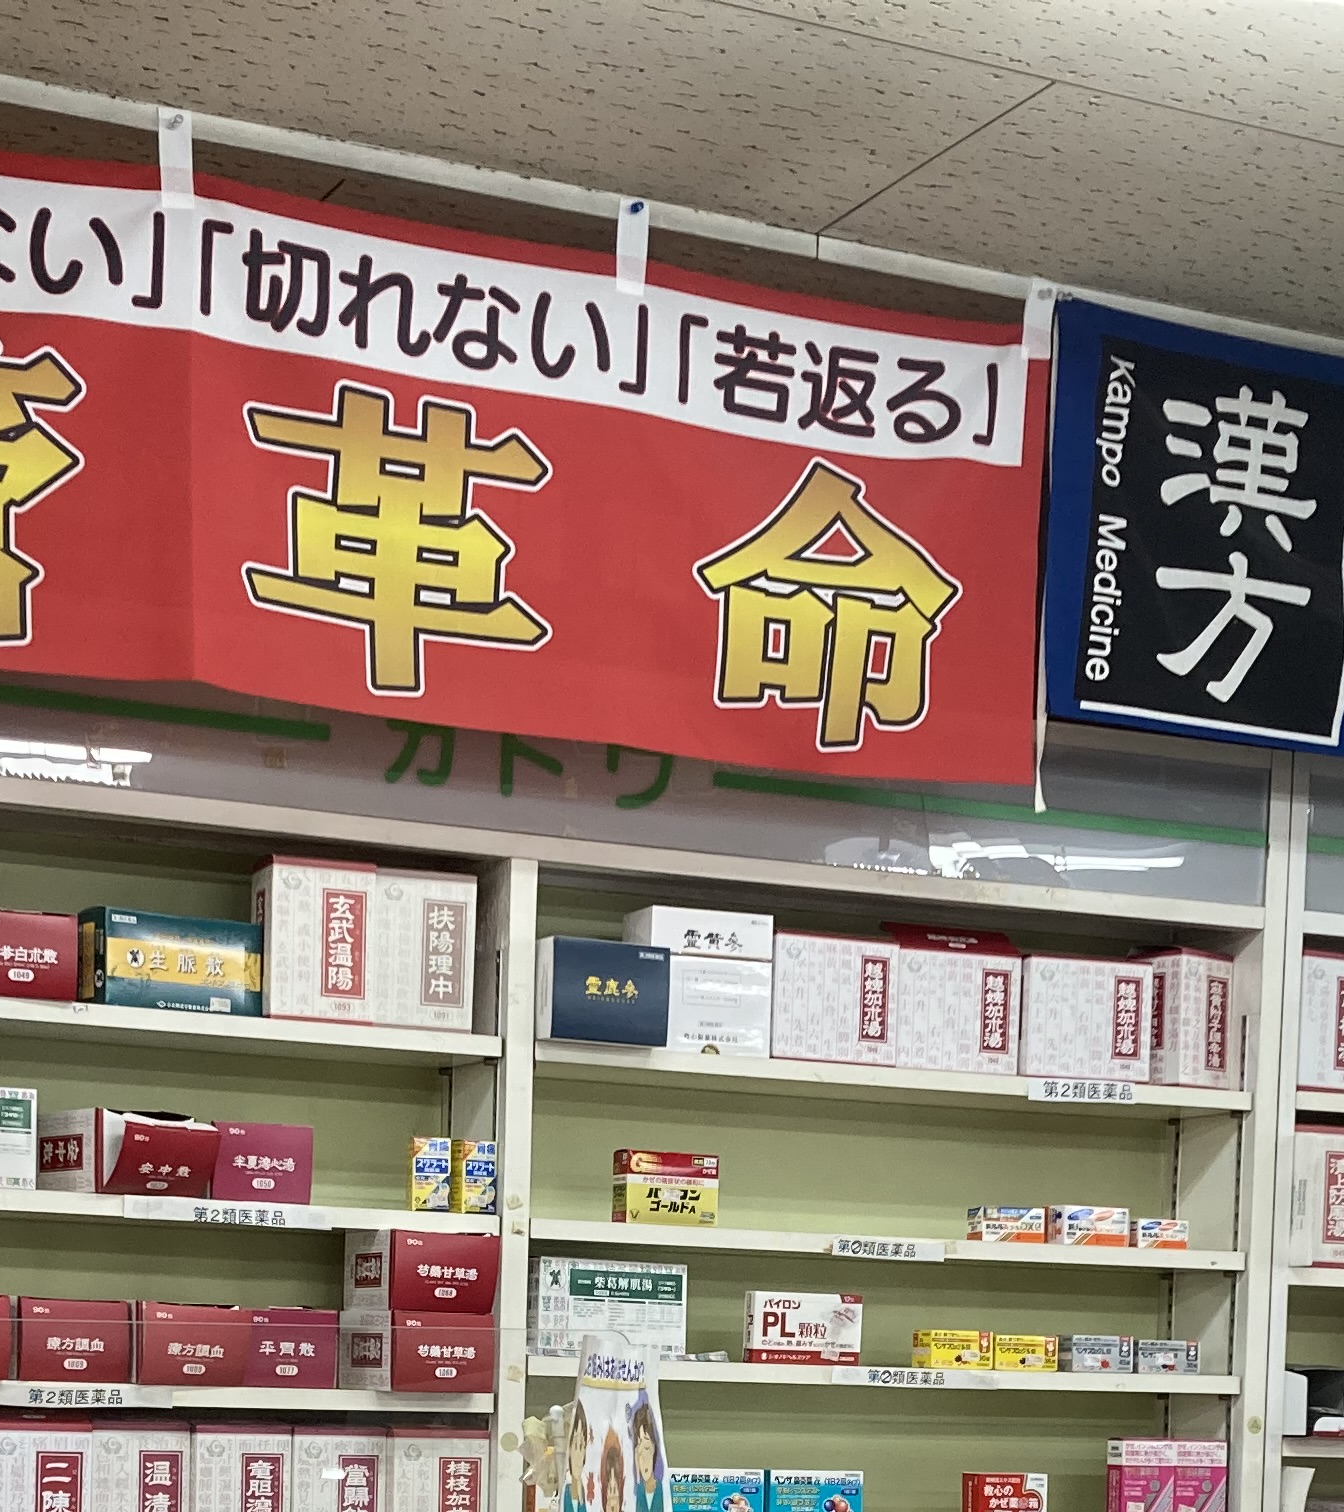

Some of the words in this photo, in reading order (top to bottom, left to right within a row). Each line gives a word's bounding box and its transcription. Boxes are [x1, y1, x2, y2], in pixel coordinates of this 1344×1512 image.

[1099, 354, 1137, 490] Kampo
[1153, 384, 1318, 704] 漢方
[1084, 513, 1127, 684] Medicine
[327, 894, 357, 992] 玄武温陽
[427, 904, 457, 996] 扶陽理中
[1043, 1080, 1135, 1101] 第2類医薬品
[192, 1206, 287, 1226] 第2類医薬品
[761, 1310, 797, 1339] PL
[27, 1388, 124, 1406] 第2類医薬品
